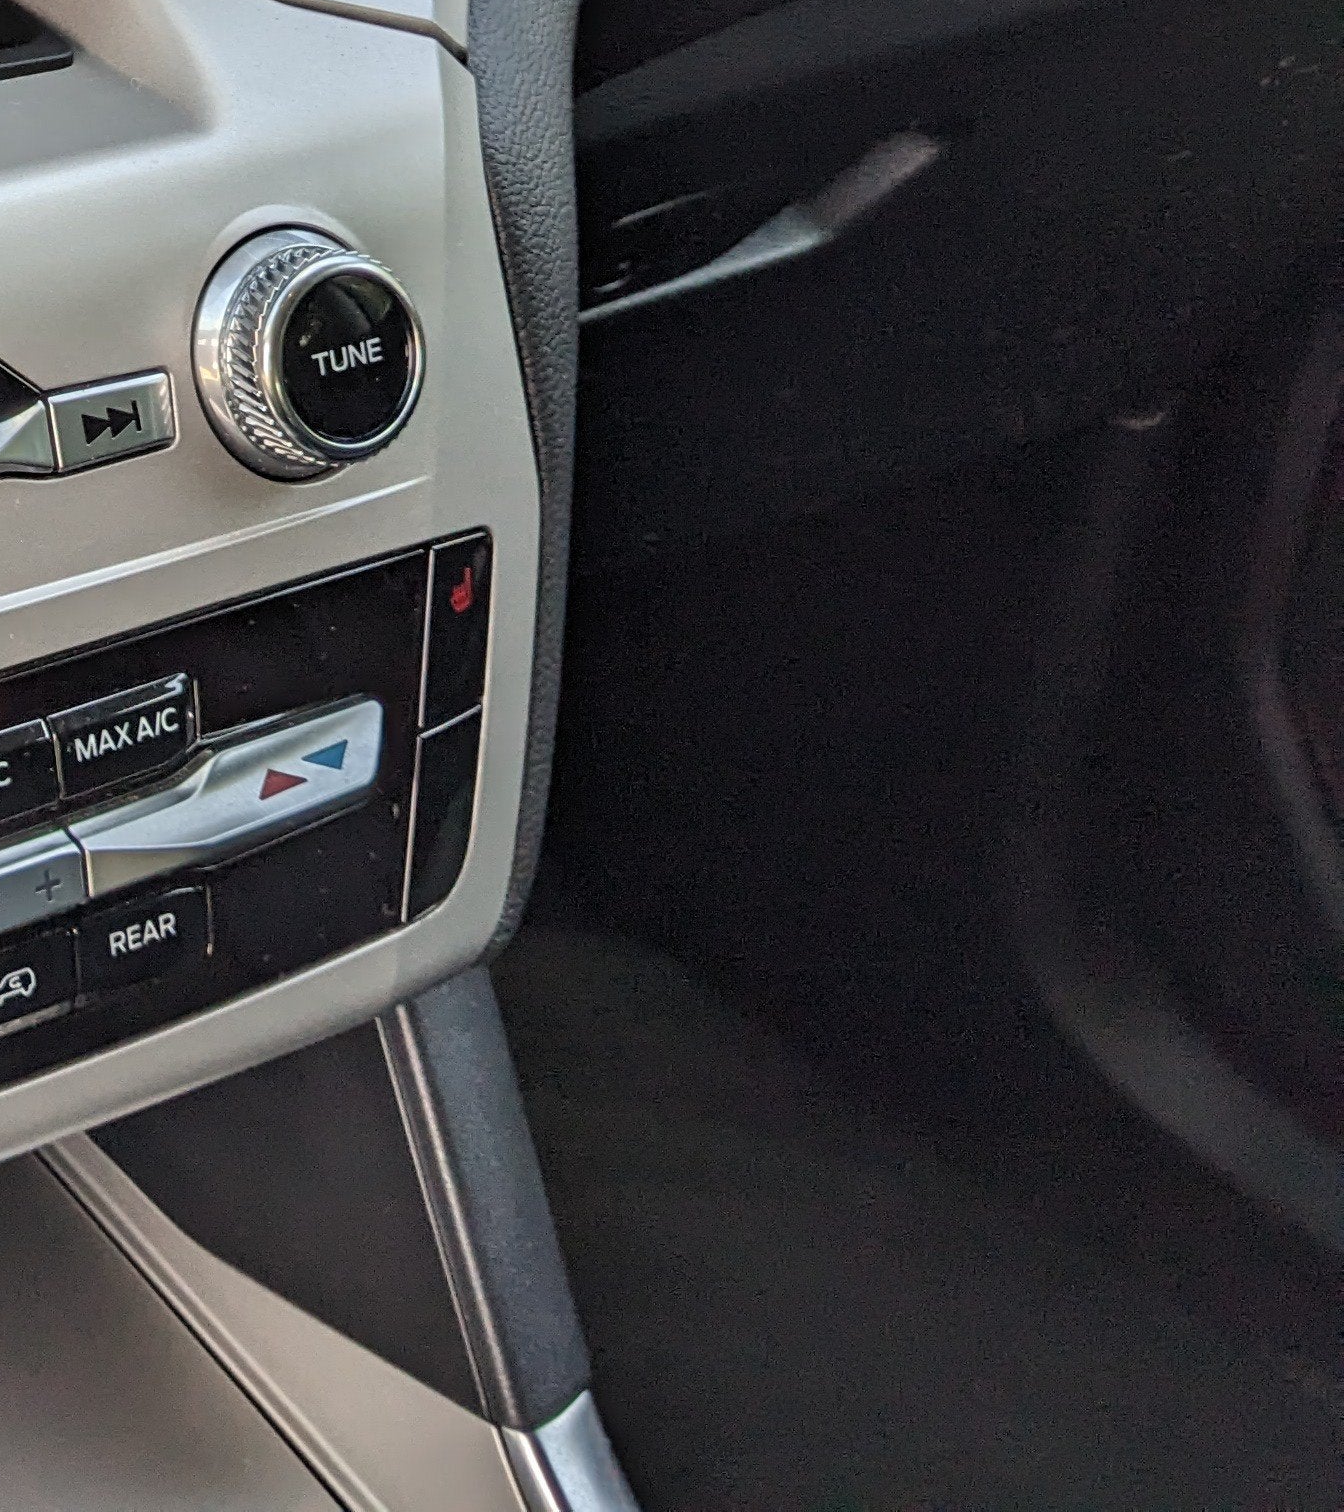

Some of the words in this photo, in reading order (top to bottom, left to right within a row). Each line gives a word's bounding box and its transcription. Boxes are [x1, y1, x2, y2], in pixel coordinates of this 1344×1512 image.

[310, 336, 384, 377] TUNE
[73, 722, 134, 764] MAX
[136, 706, 180, 746] A/C
[108, 911, 177, 959] REAR
